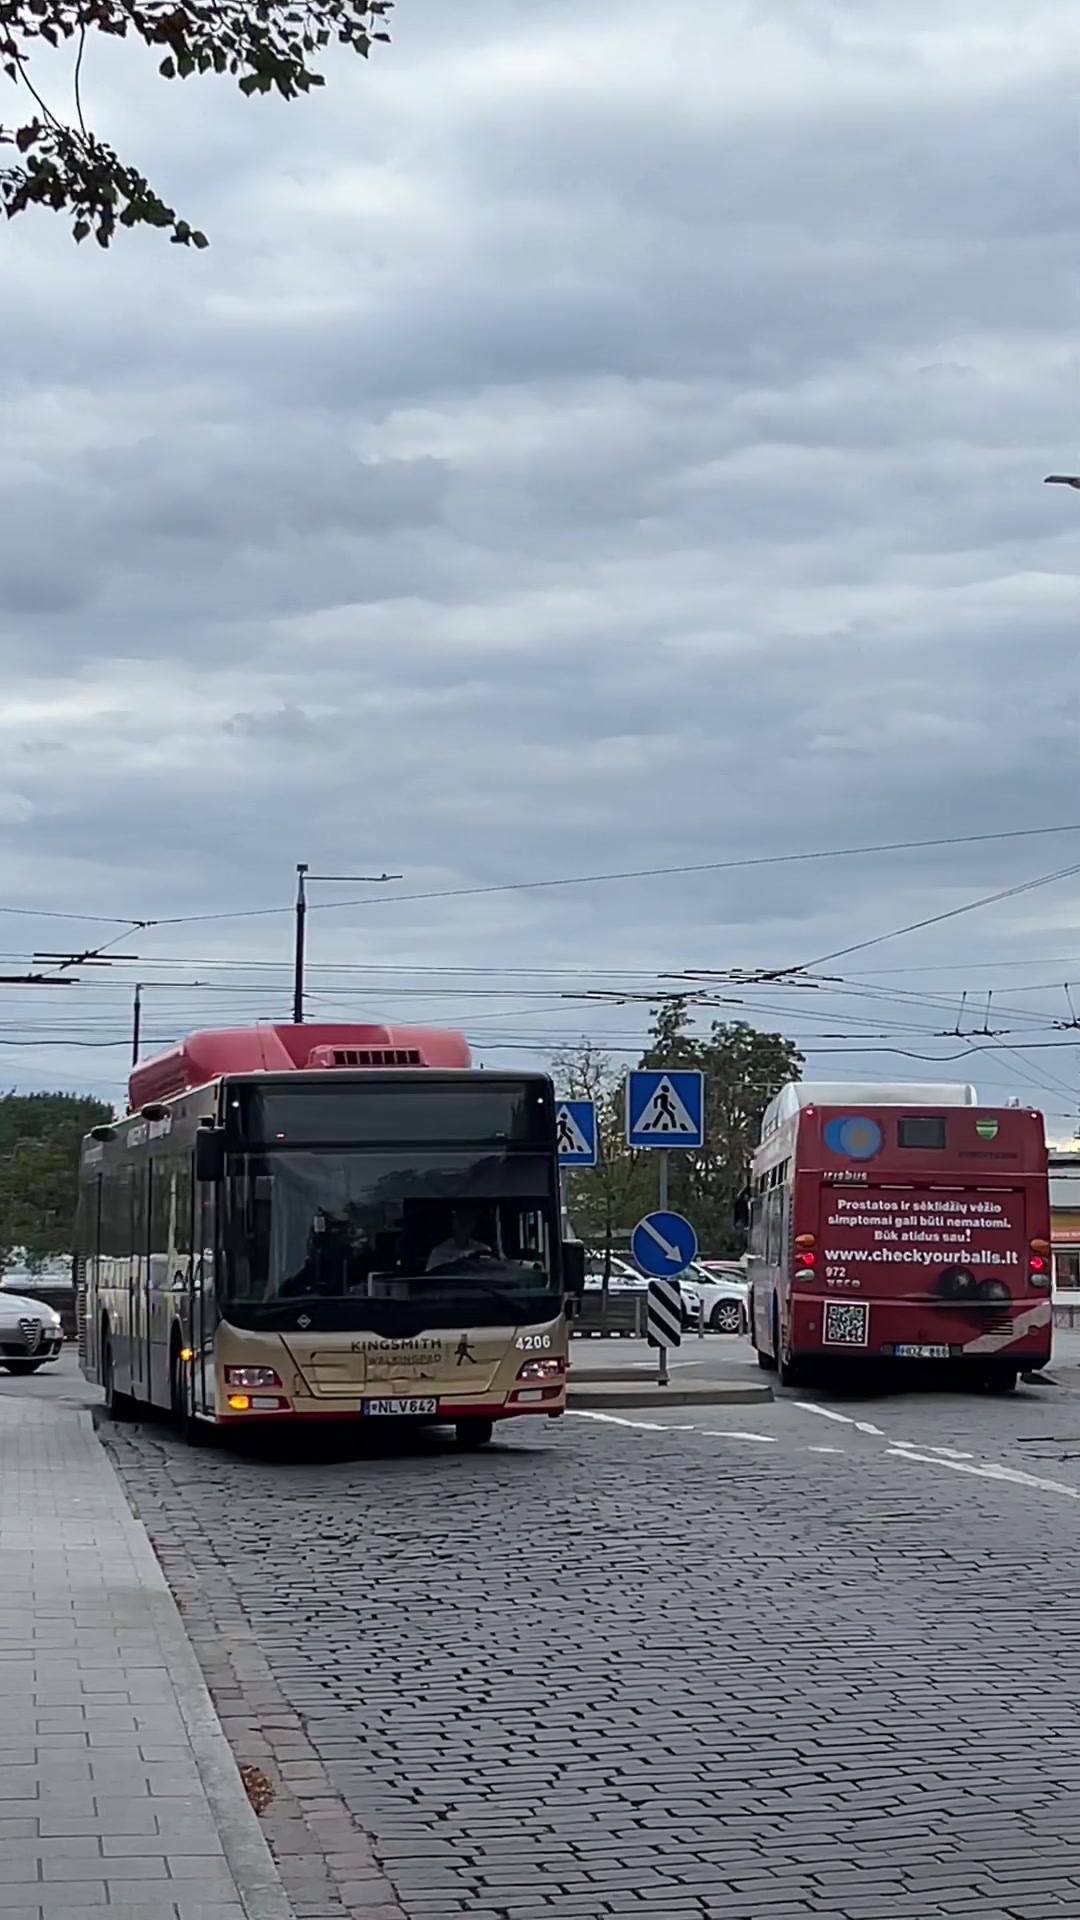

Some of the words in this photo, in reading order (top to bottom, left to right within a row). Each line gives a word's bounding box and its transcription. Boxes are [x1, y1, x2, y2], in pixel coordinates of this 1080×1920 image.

[837, 1199, 898, 1211] Prostatos
[900, 1200, 911, 1211] ir
[828, 1214, 893, 1227] simptomai
[894, 1215, 918, 1228] gali
[919, 1215, 944, 1227] būti
[946, 1217, 1012, 1229] nematomi.
[874, 1229, 899, 1241] Būk
[901, 1230, 940, 1242] atidus
[942, 1229, 972, 1243] sau!
[824, 1247, 1019, 1265] www.checkyourballs.lt
[825, 1266, 846, 1278] 972
[350, 1338, 442, 1351] KINGSMITH
[514, 1335, 551, 1350] 4206
[367, 1354, 442, 1366] WALKINGPAD
